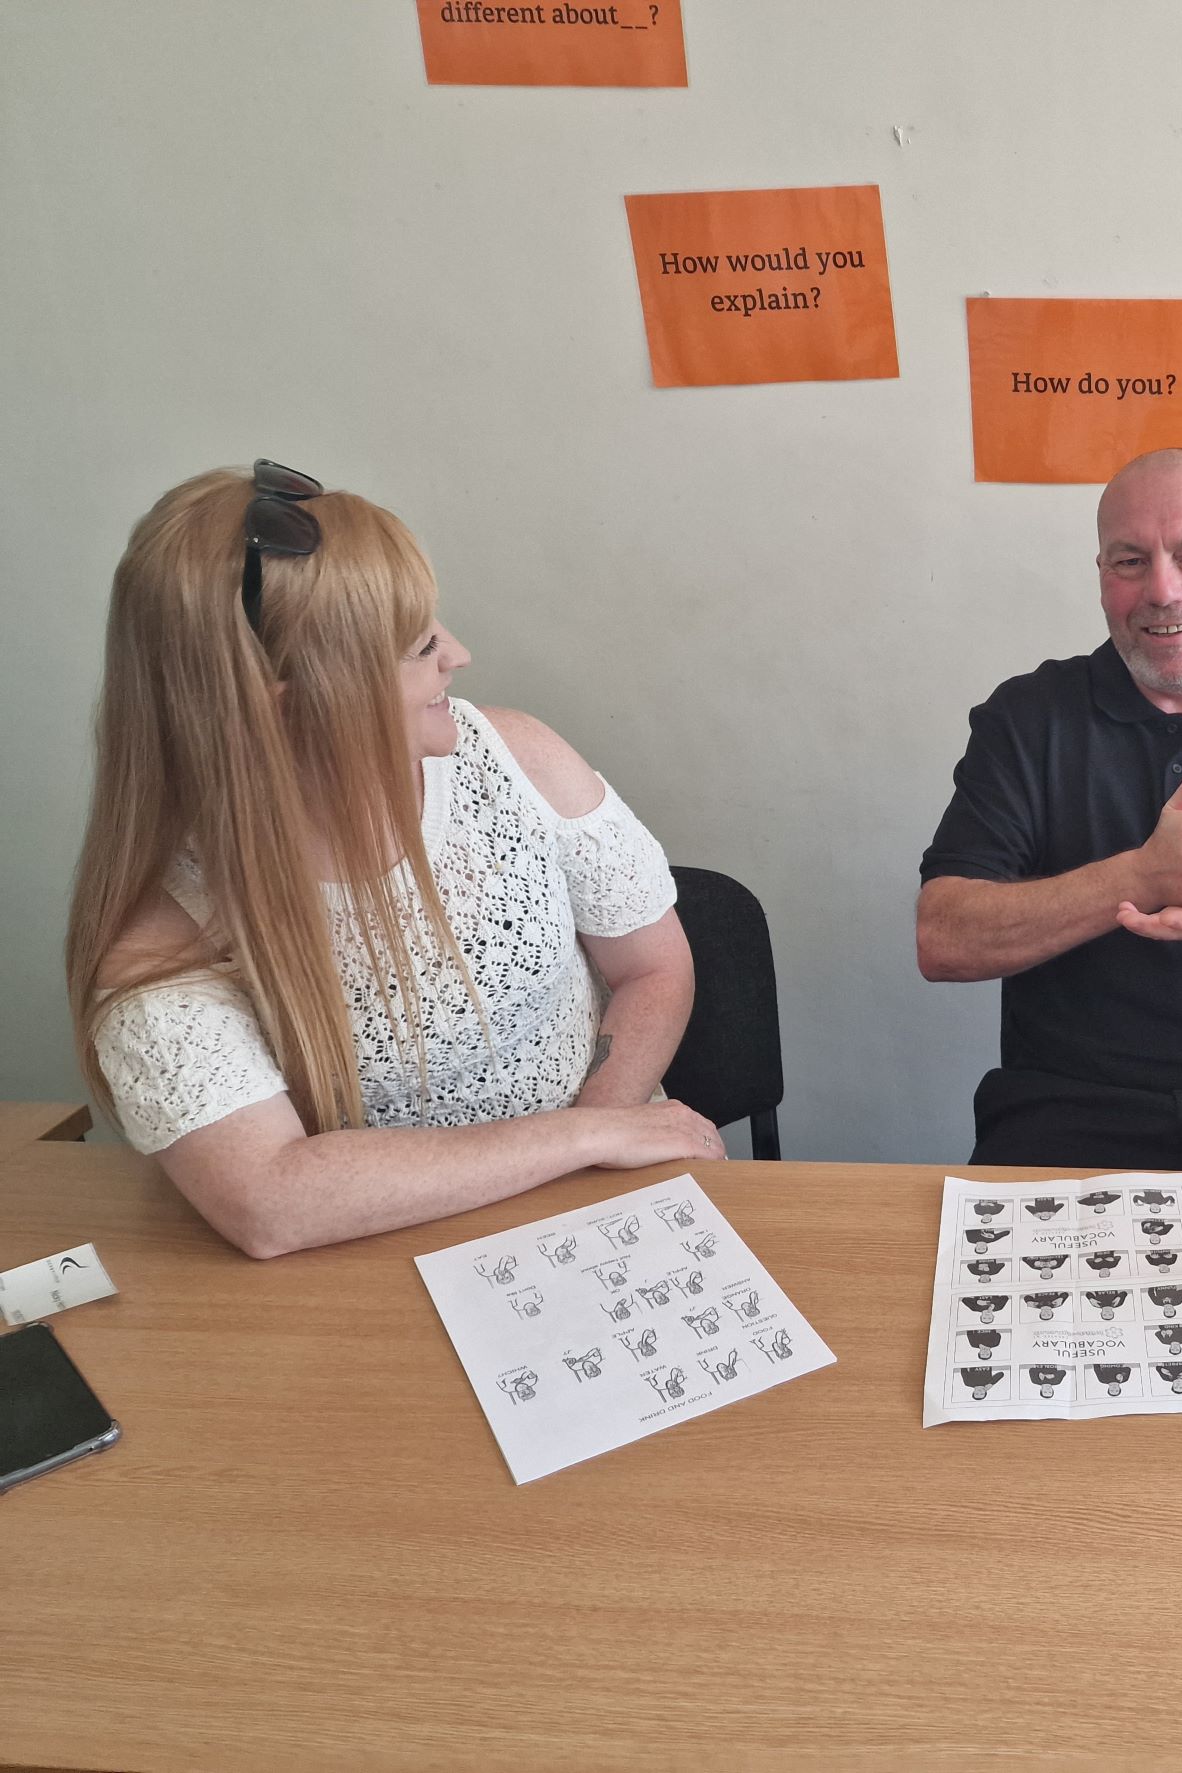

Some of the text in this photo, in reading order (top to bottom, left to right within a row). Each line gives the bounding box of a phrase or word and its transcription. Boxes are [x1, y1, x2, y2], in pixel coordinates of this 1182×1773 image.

[440, 1, 546, 25] different
[659, 247, 866, 276] How would you
[710, 286, 822, 319] explain?
[1011, 372, 1177, 400] How do you?
[1031, 1231, 1116, 1243] VOCABULARY
[1049, 1239, 1098, 1250] USEFUL
[741, 1313, 778, 1329] QUESTION
[611, 1328, 635, 1340] APPLE
[695, 1345, 719, 1357] DRINK
[1031, 1339, 1126, 1349] VOCABULARY
[1052, 1348, 1106, 1358] USEFUL
[639, 1364, 667, 1378] WATER
[637, 1391, 713, 1423] FOOD AND DRINK
